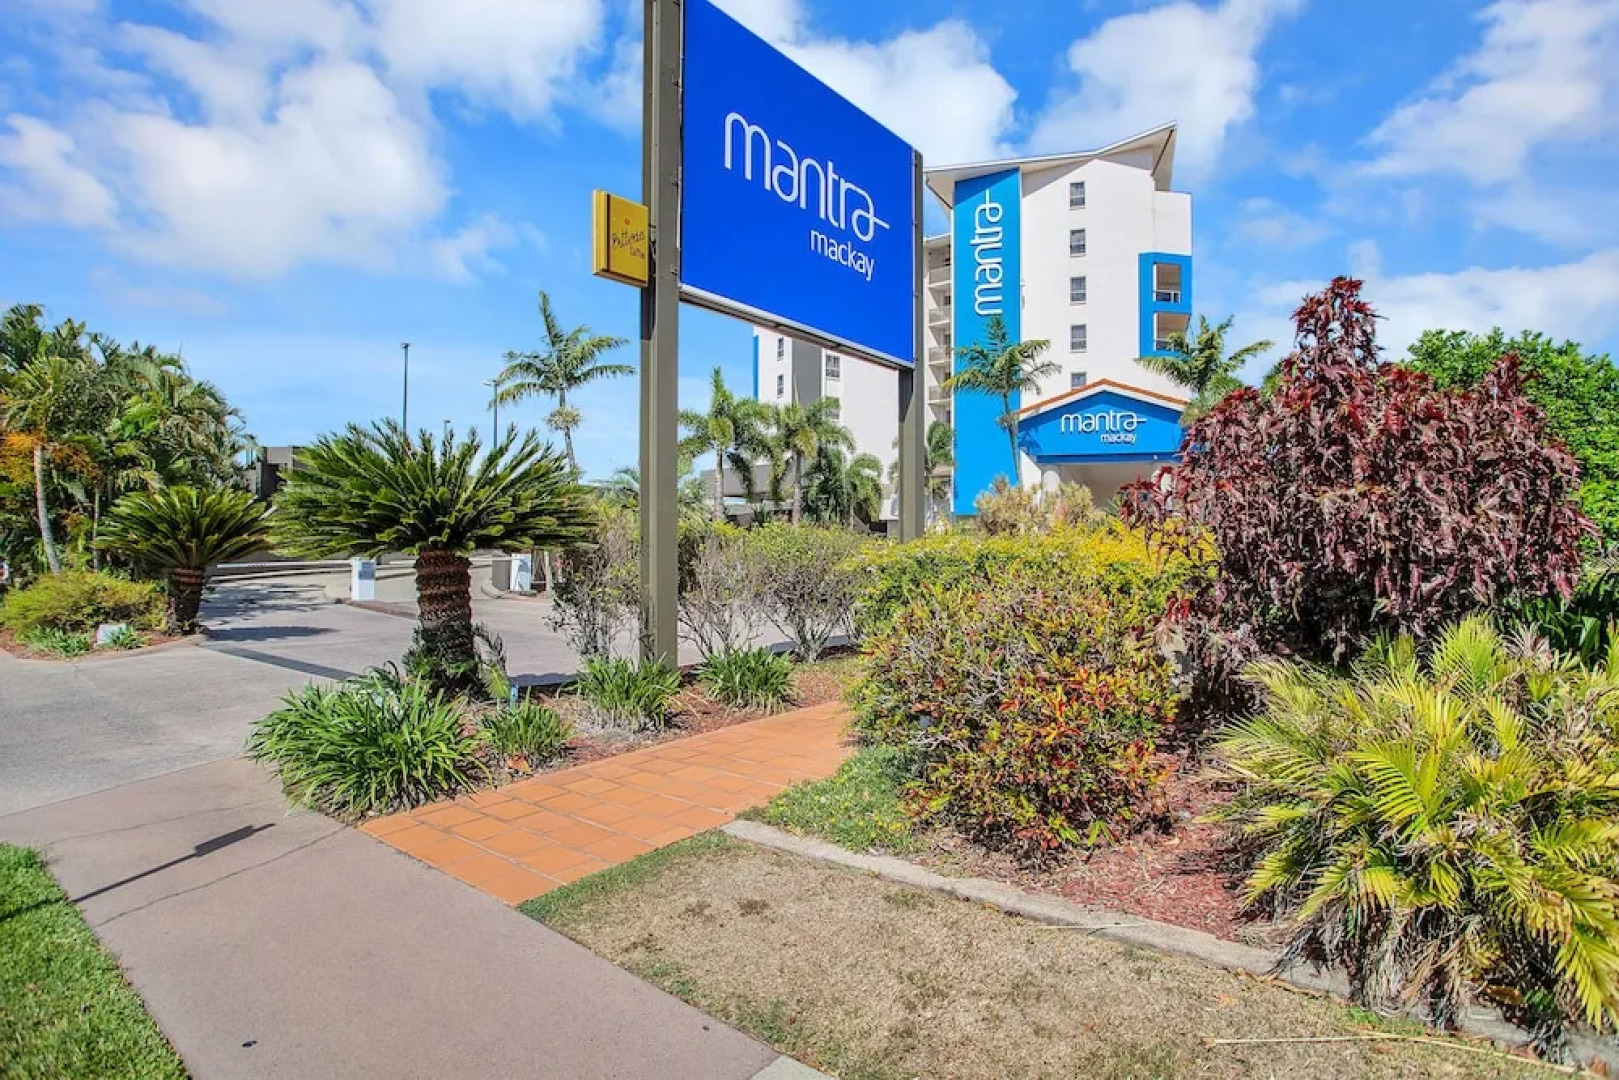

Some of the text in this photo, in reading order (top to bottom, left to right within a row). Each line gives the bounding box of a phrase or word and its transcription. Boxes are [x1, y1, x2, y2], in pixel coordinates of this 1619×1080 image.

[724, 112, 890, 242] mantra
[810, 229, 875, 282] mackay
[970, 188, 1003, 316] mantra
[1061, 410, 1147, 433] mantra
